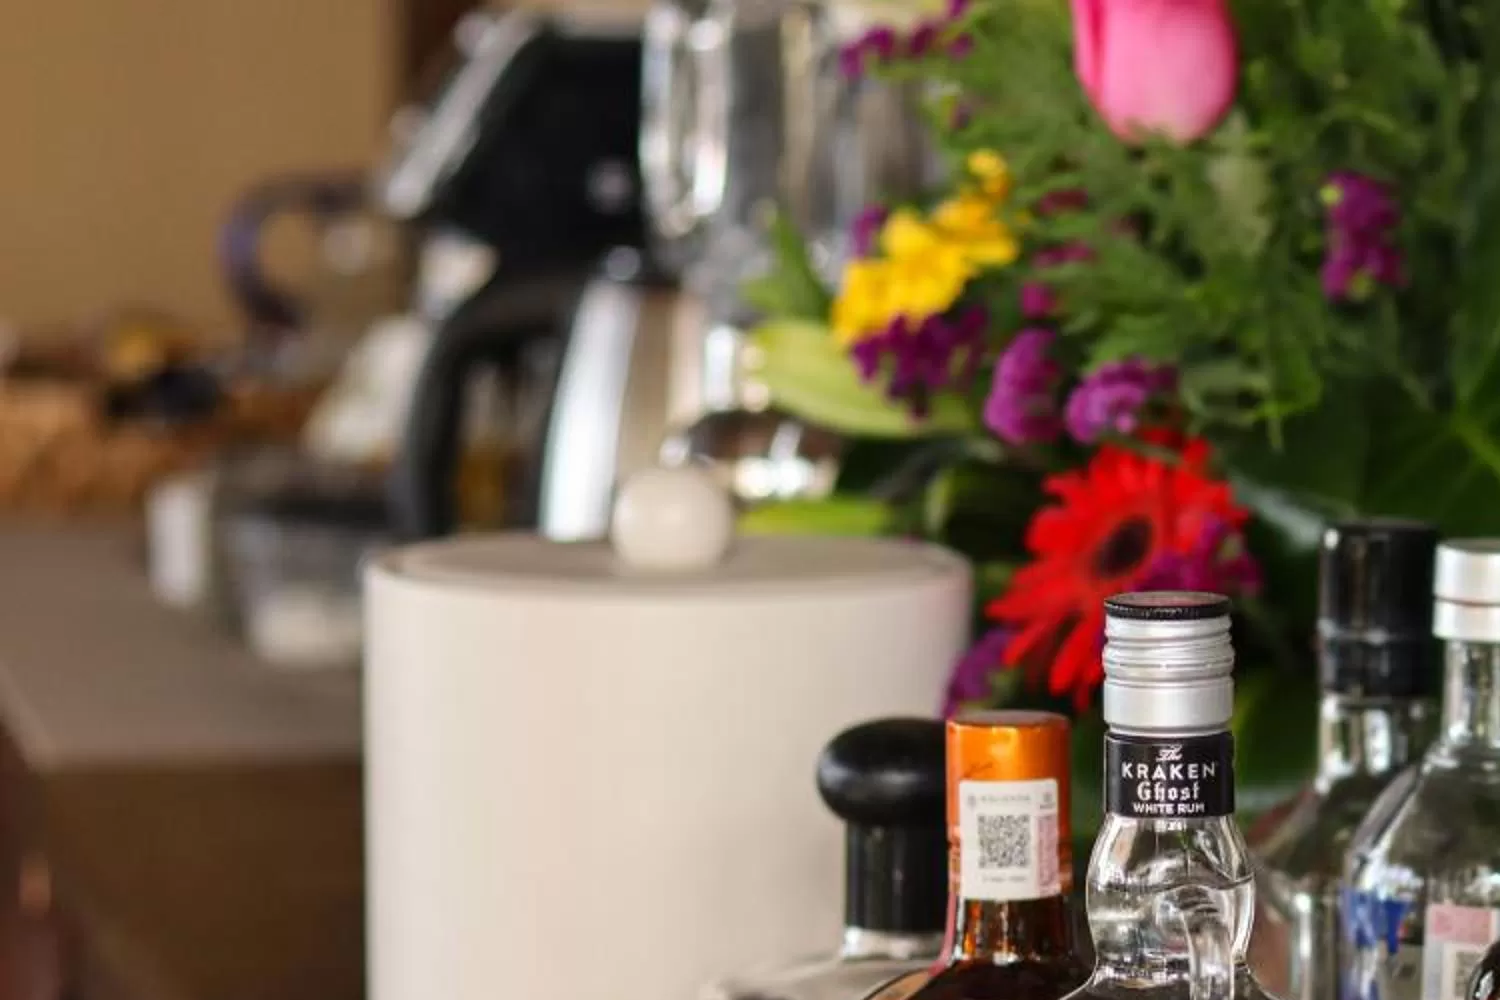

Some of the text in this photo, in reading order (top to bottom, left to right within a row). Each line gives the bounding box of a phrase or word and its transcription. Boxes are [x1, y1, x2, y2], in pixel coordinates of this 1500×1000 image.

[1121, 762, 1216, 781] KRAKEN
[1137, 781, 1201, 803] Ghost
[1133, 803, 1206, 814] WHITE RUM
